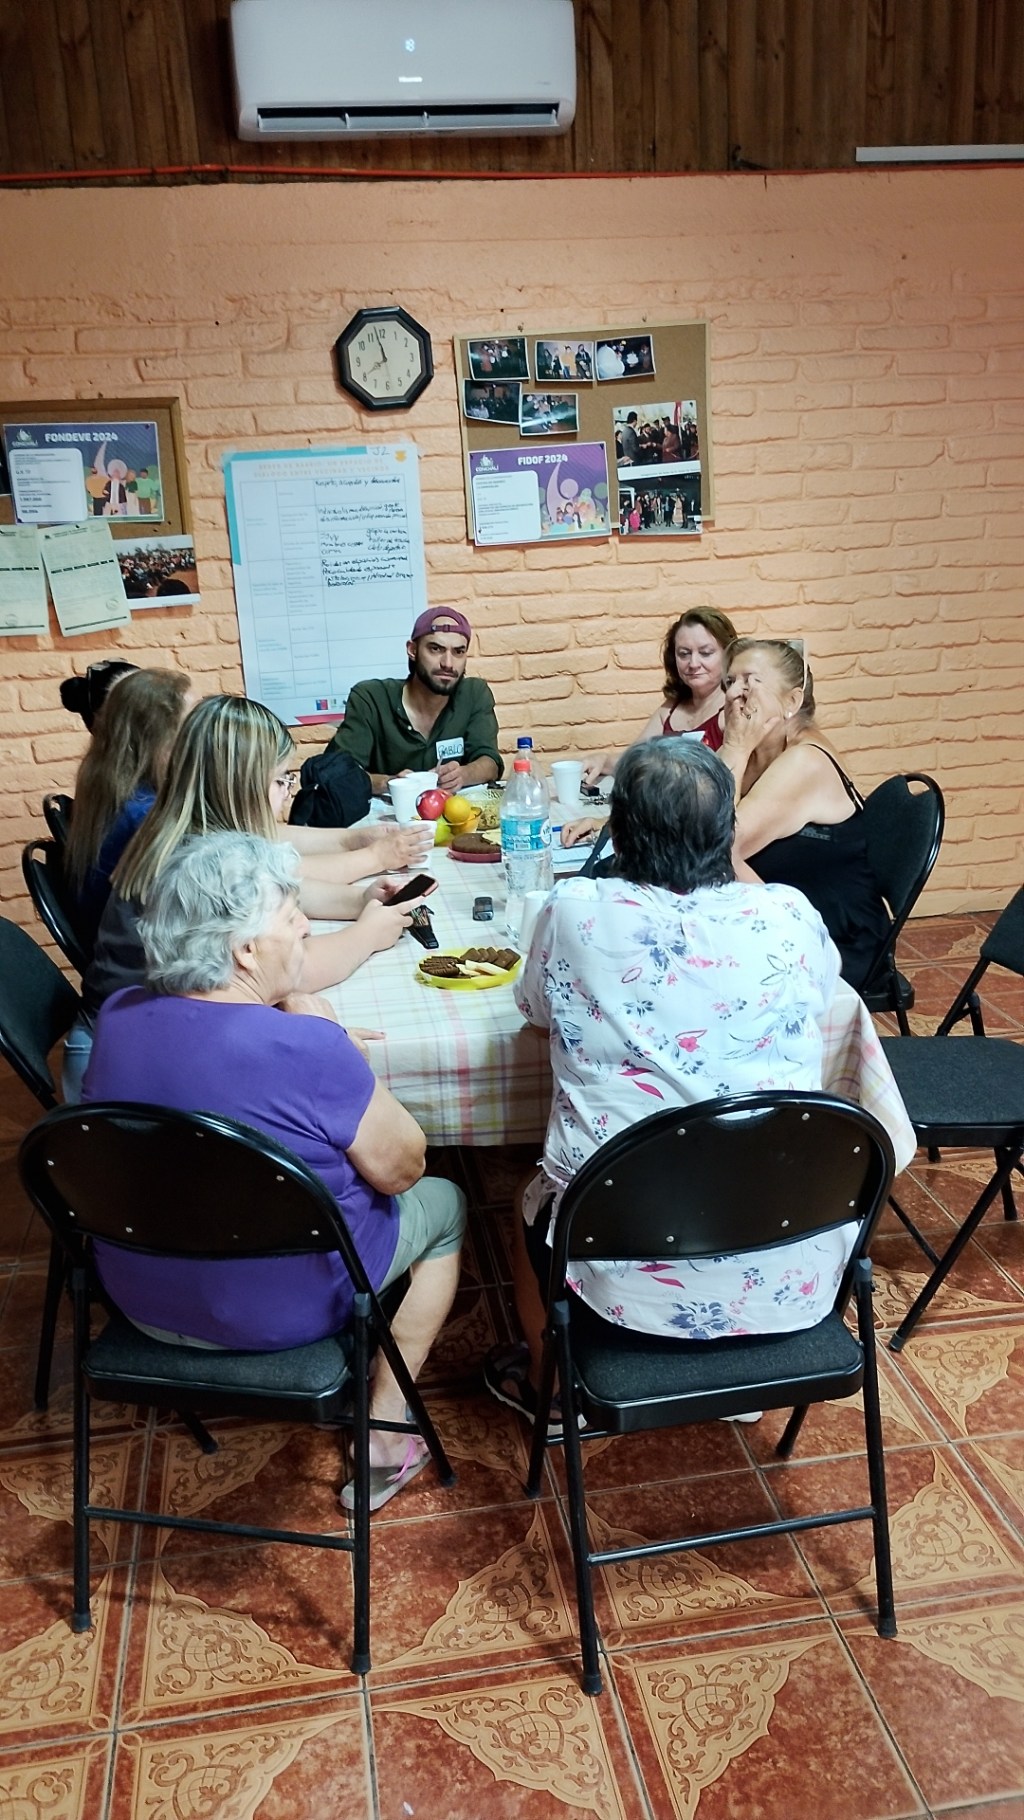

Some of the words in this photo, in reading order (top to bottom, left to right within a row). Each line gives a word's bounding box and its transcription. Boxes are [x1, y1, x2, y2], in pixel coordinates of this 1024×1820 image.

[368, 333, 374, 342] 11
[379, 329, 386, 339] 12
[394, 331, 397, 340] 1
[358, 341, 365, 351] 10
[404, 337, 408, 348] 2
[356, 357, 361, 367] 9
[410, 352, 414, 363] 3
[363, 372, 367, 382] 8
[406, 369, 411, 378] 4
[374, 379, 377, 388] 7
[385, 381, 390, 391] 6
[397, 377, 403, 387] 5
[45, 433, 91, 442] FONDEVE
[92, 432, 118, 442] 2024
[517, 456, 544, 465] FIDOF
[544, 453, 568, 464] 2024
